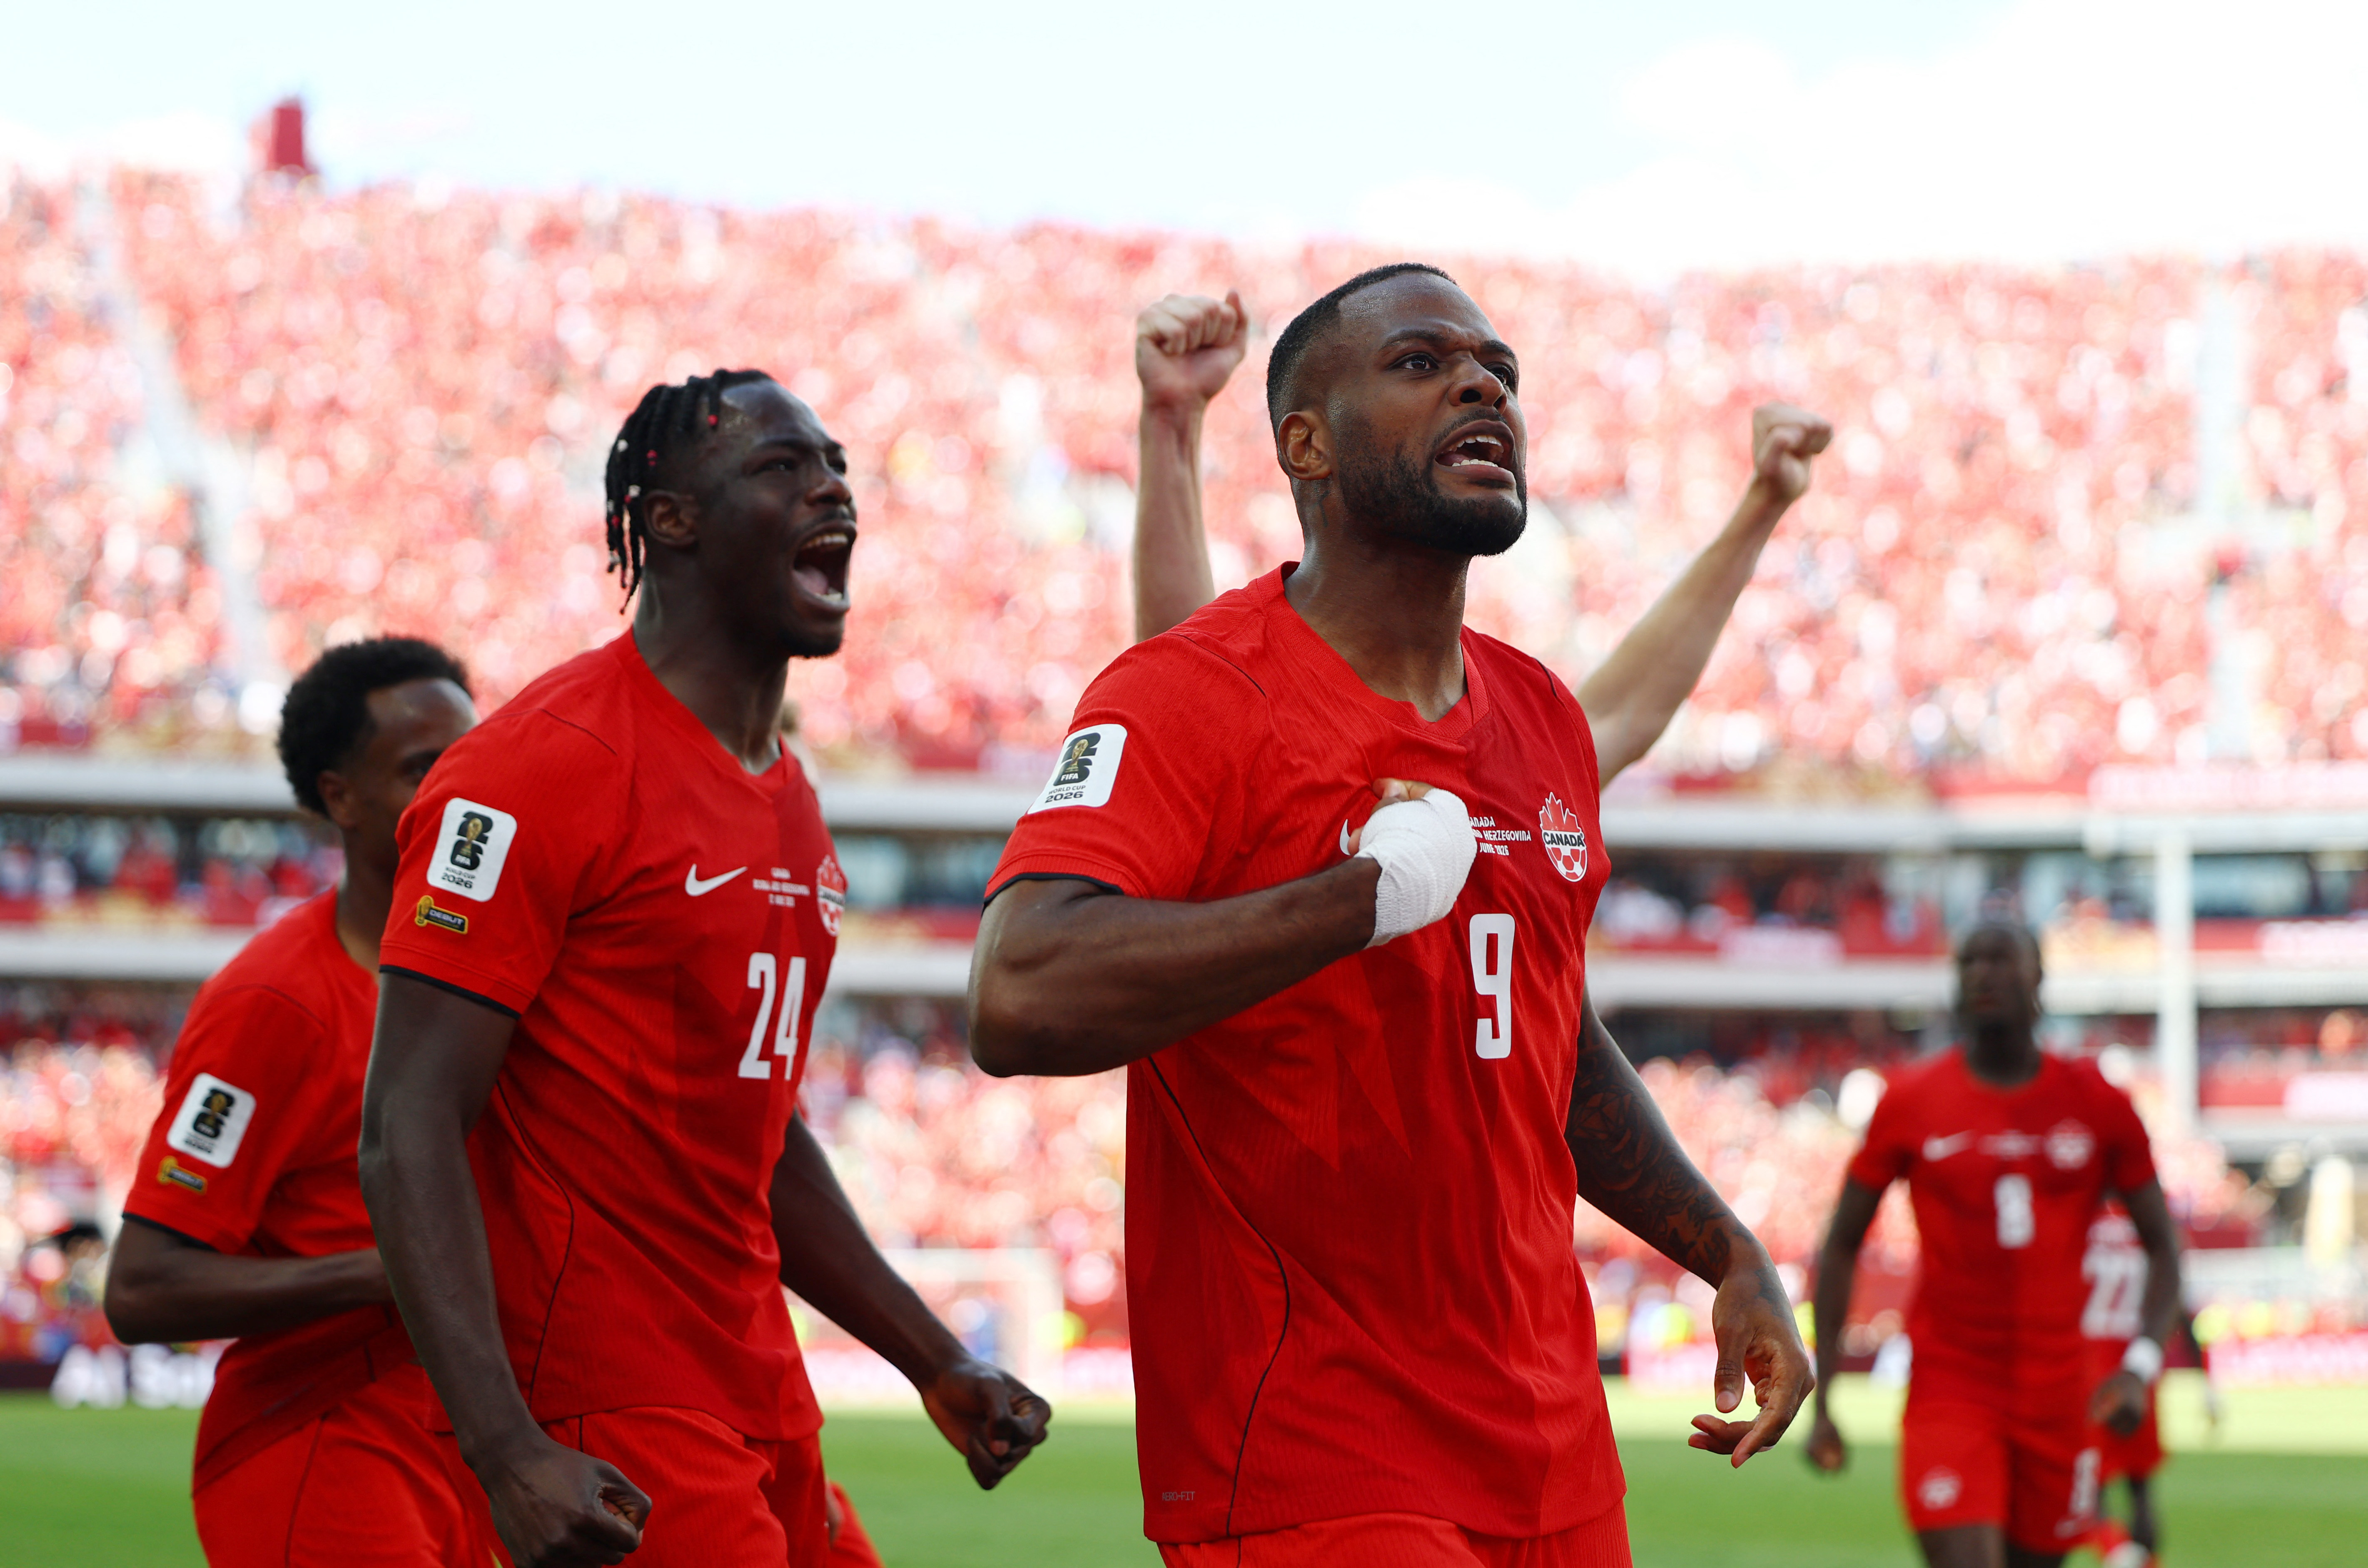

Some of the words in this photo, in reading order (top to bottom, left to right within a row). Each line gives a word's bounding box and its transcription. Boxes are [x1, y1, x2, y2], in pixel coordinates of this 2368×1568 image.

[1061, 773, 1079, 781] FIFA
[1044, 791, 1084, 803] 2026
[1048, 786, 1071, 795] WORLD
[1470, 816, 1496, 827] ANADA
[1483, 830, 1531, 841] HERZEGOVINA
[1543, 832, 1585, 847] CANADA
[1480, 842, 1496, 854] JUNE
[1494, 845, 1509, 856] 2026
[441, 872, 473, 889] 2026
[429, 909, 464, 925] DEBUT
[1469, 913, 1515, 1059] 9
[738, 952, 806, 1081] 24
[1162, 1491, 1195, 1501] AERO-FIT
